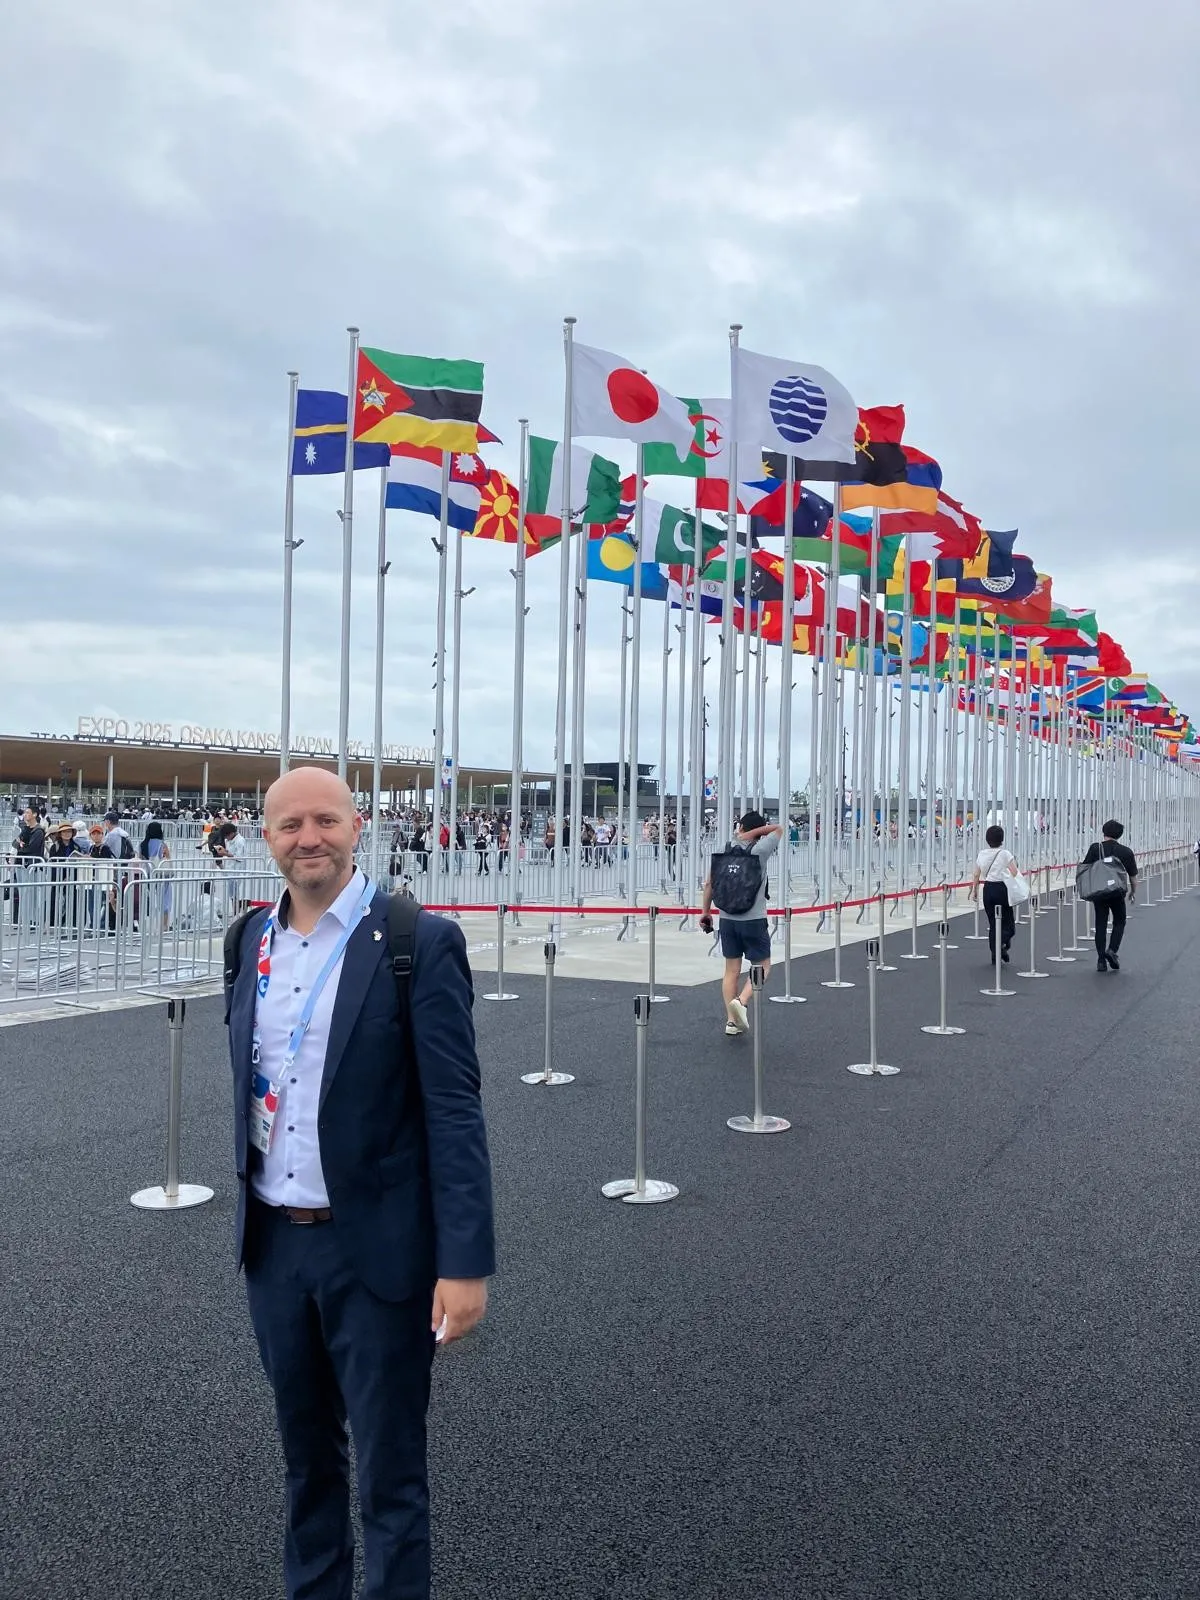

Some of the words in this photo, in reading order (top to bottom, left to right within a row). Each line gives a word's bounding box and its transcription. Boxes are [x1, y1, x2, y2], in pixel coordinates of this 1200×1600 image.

[78, 715, 129, 737] EXPO
[134, 722, 172, 741] 2025
[180, 725, 233, 747] OSAKA
[237, 730, 282, 750] KANSA
[293, 736, 332, 754] JAPAN
[413, 746, 435, 762] GAT
